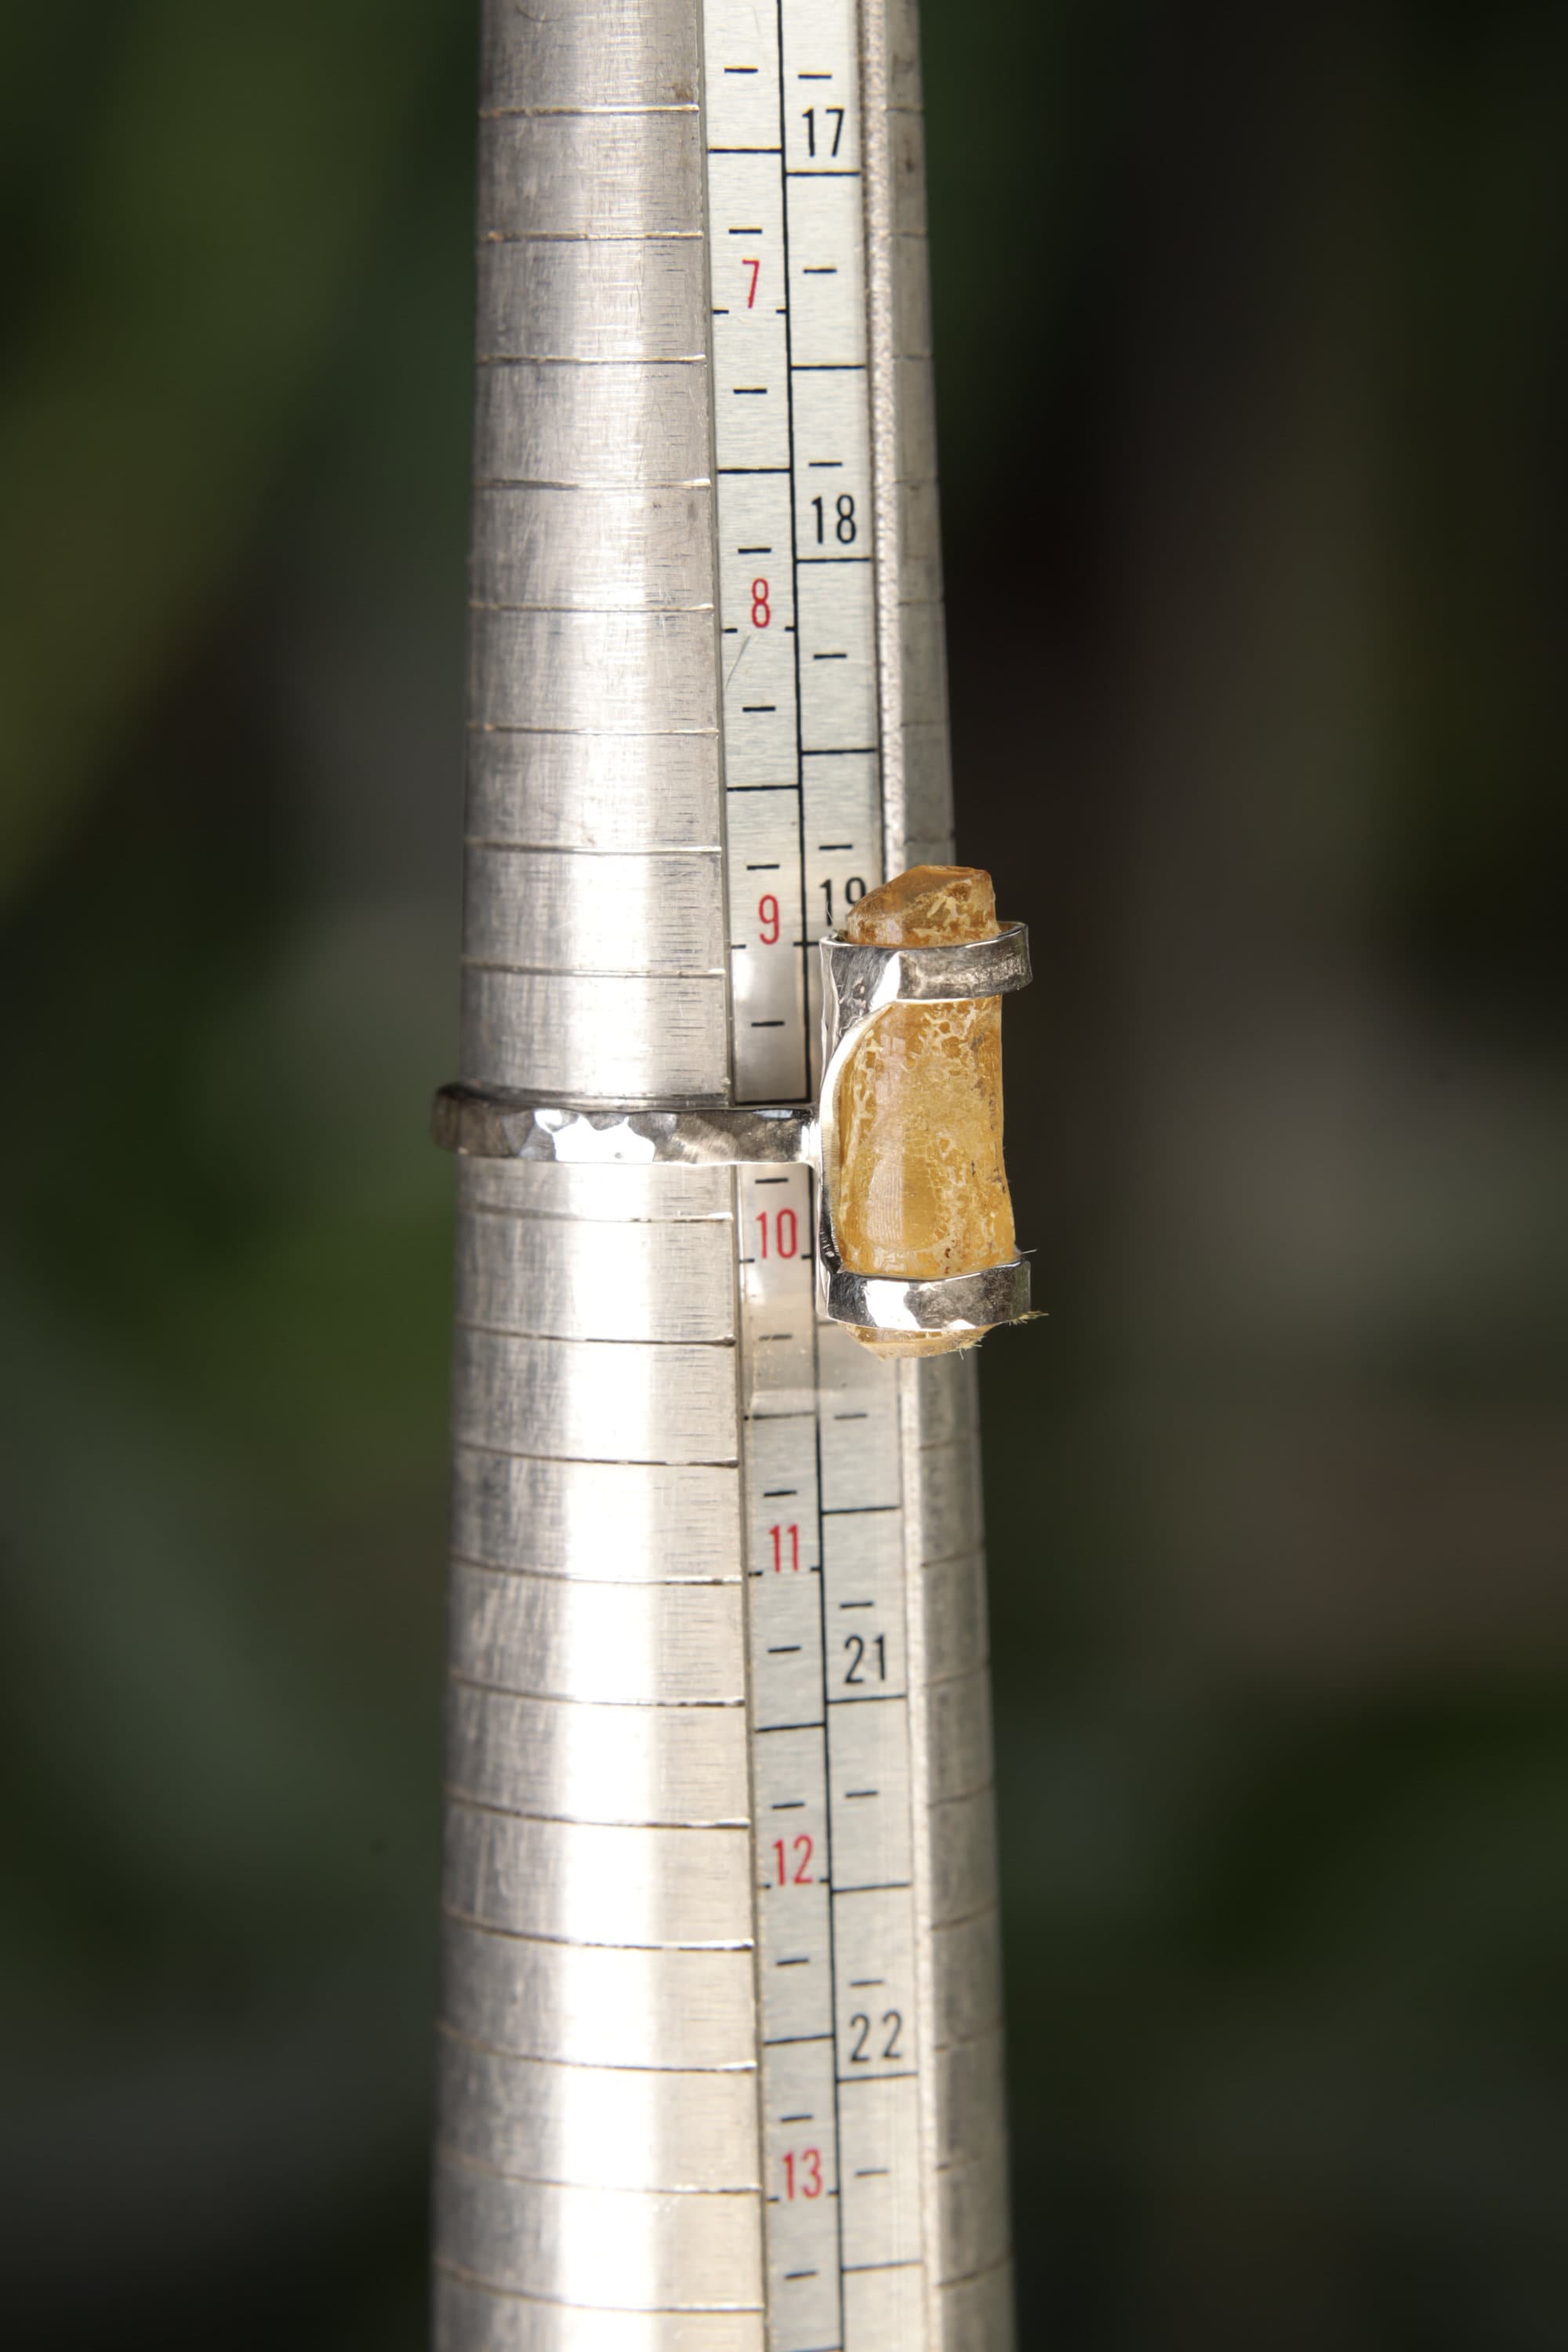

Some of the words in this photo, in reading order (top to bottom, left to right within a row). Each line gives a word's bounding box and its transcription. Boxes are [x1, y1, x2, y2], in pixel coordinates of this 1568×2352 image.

[804, 109, 844, 155] 17
[742, 259, 760, 308] 7
[812, 495, 856, 543] 18
[751, 578, 771, 627] 8
[758, 894, 779, 945] 9
[756, 1207, 798, 1259] 10
[769, 1523, 799, 1573] 11
[845, 1635, 884, 1684] 21
[773, 1834, 813, 1886] 12
[851, 2013, 900, 2061] 22
[782, 2148, 822, 2199] 13
